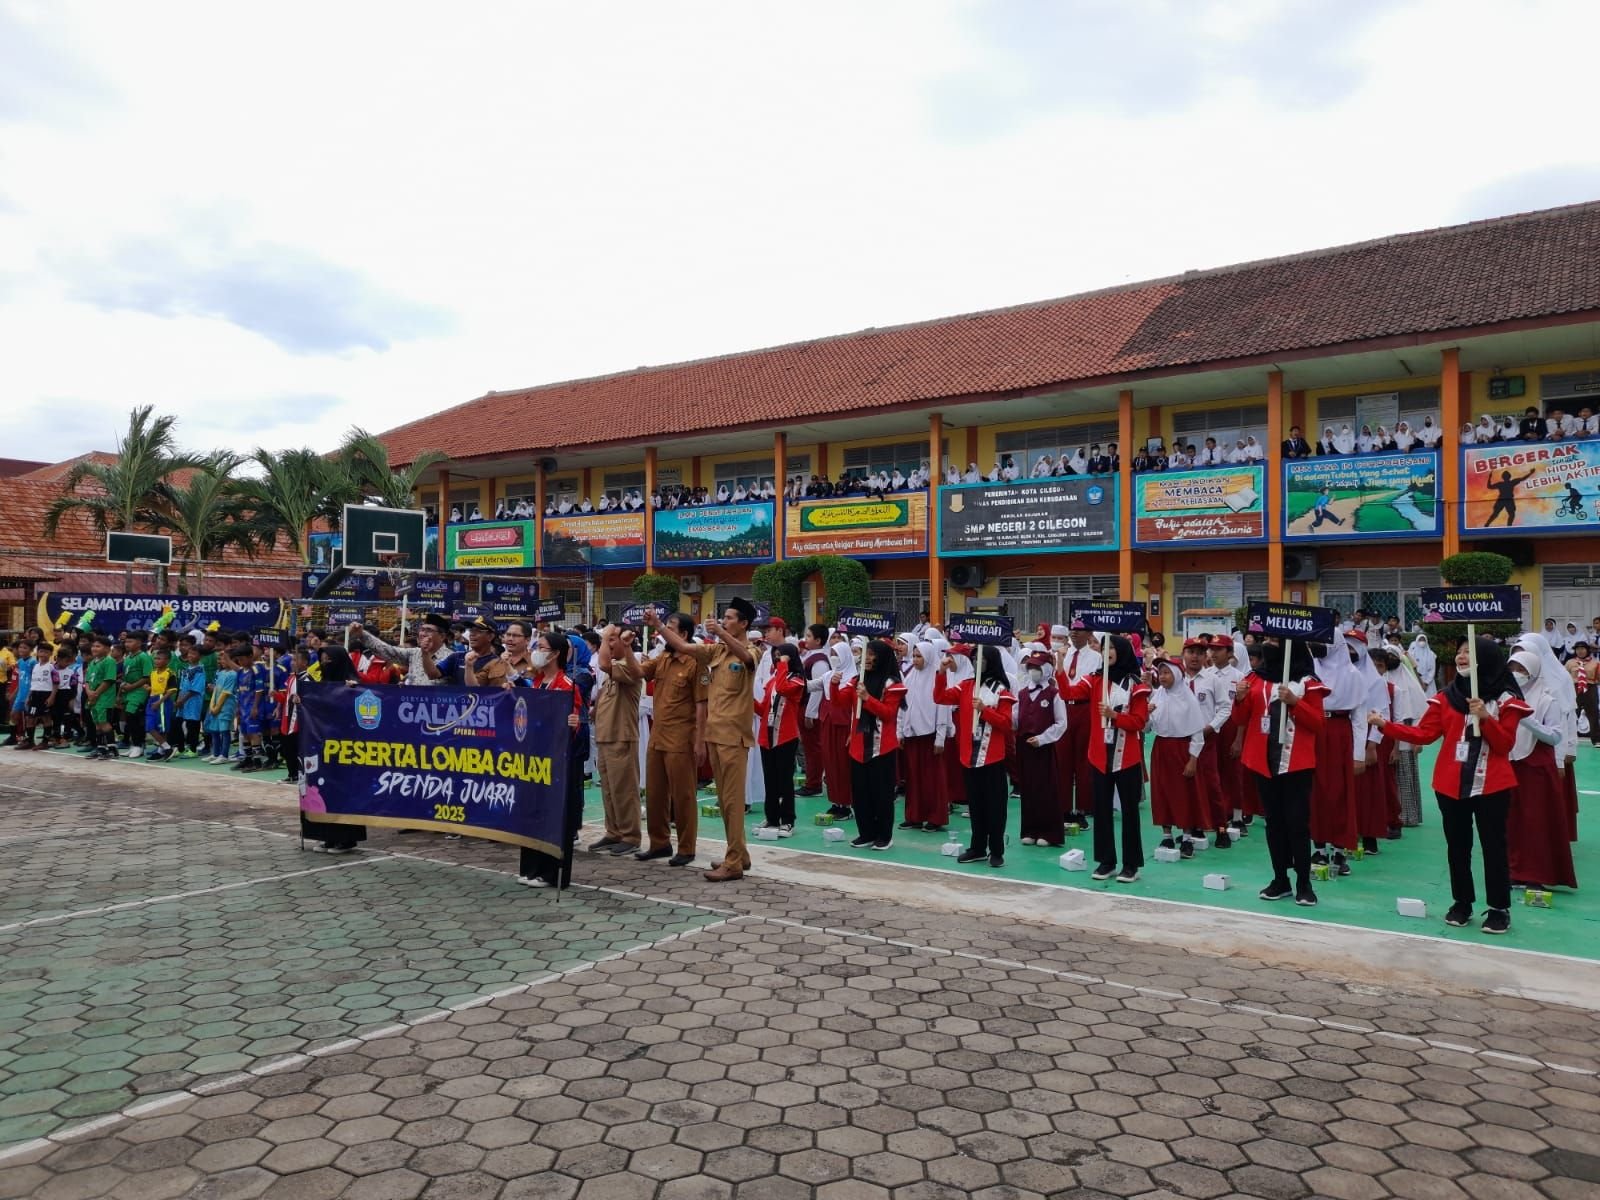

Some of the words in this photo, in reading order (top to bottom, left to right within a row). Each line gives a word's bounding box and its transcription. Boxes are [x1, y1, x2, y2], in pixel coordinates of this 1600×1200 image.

[1474, 444, 1581, 473] BERGERAK
[1547, 461, 1587, 474] HIDUP
[1526, 475, 1562, 489] LEBIH
[1021, 488, 1038, 496] KOTA
[1164, 486, 1223, 497] MEMBACA
[991, 499, 1026, 507] PENDIDIKAN
[964, 524, 985, 535] SMP
[988, 521, 1026, 534] NEGERI
[1029, 521, 1036, 531] 2
[1038, 517, 1087, 531] CILEGON
[1446, 592, 1467, 601] MATA
[1468, 592, 1494, 600] LOMBA
[61, 597, 122, 611] SELAMAT
[124, 599, 181, 612] DATANG
[182, 601, 191, 612] &
[193, 600, 270, 613] BERTANDING
[1438, 601, 1466, 613] SOLO
[1468, 600, 1504, 613] VOKAL
[1269, 607, 1288, 616] MATA
[1289, 609, 1312, 618] LOMBA
[846, 616, 890, 630] CERAMAH
[959, 623, 1002, 637] KALIGRAFI
[1266, 615, 1314, 632] MELUKIS
[398, 702, 496, 728] GALAKSI
[323, 739, 418, 769] PESERTA
[420, 745, 496, 776] LOMBA
[497, 751, 552, 785] GALAXI
[374, 771, 454, 804] SPENDA
[459, 779, 516, 815] JUARA
[434, 804, 466, 822] 2023
